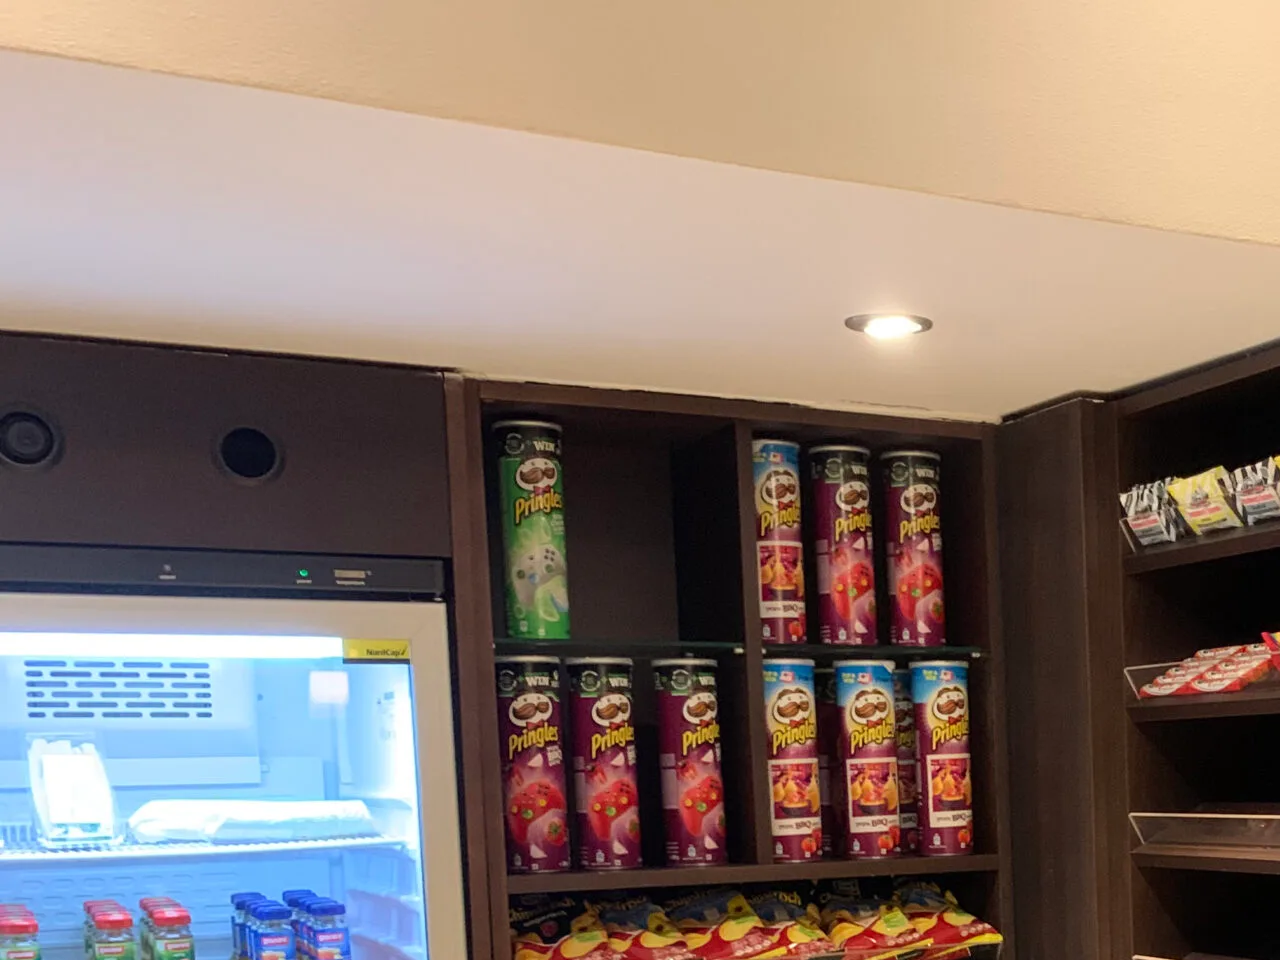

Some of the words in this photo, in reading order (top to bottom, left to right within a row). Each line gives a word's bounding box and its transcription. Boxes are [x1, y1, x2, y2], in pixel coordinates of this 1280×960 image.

[761, 506, 801, 536] Pringle
[835, 509, 872, 540] Pringle
[509, 722, 558, 759] Pringles
[682, 722, 720, 755] Pringle
[851, 720, 894, 755] Pringles
[932, 718, 969, 750] Pringle
